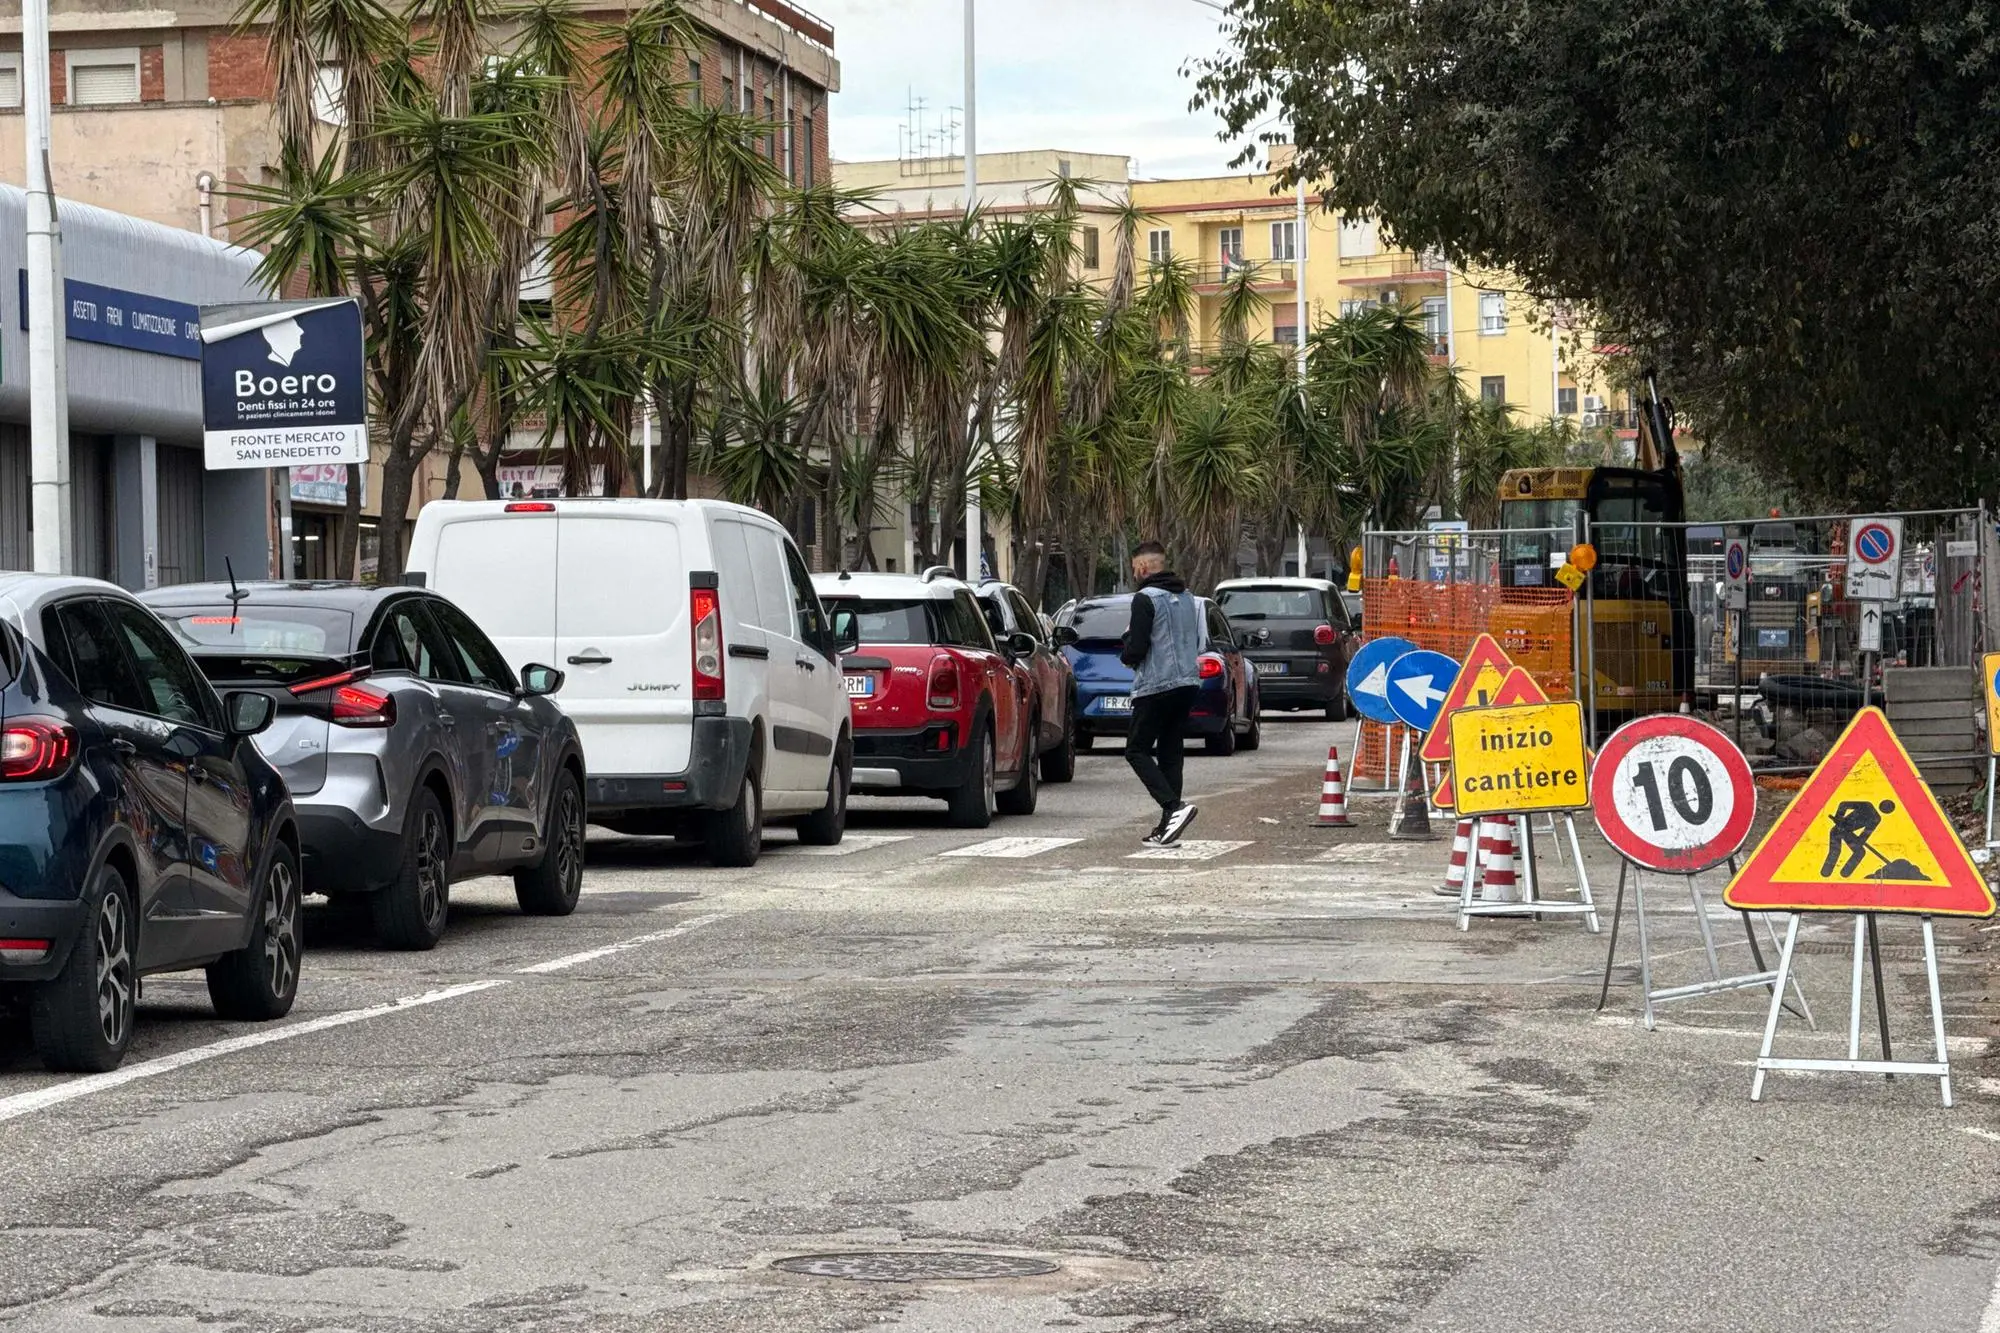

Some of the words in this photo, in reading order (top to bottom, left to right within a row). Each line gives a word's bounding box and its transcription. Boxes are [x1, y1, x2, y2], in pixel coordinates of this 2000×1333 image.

[73, 300, 97, 322] ASSETTO
[106, 306, 123, 326] FRENI
[132, 311, 177, 336] CLIMATIZZAZIONE
[235, 369, 336, 397] Boero
[237, 400, 266, 411] Denti
[268, 400, 287, 410] fissi
[289, 399, 299, 409] in
[301, 398, 315, 408] 24
[318, 399, 336, 408] ore
[245, 411, 272, 420] pazienti
[273, 409, 314, 418] clinicamente
[315, 408, 336, 416] idonei
[230, 433, 282, 446] FRONTE
[285, 431, 345, 444] MERCATO
[236, 448, 261, 460] SAN
[264, 446, 341, 459] BENEDETTO
[627, 683, 681, 691] JUMPY
[1480, 725, 1553, 751] inizio
[1464, 765, 1578, 793] cantiere
[1632, 755, 1713, 832] 10
